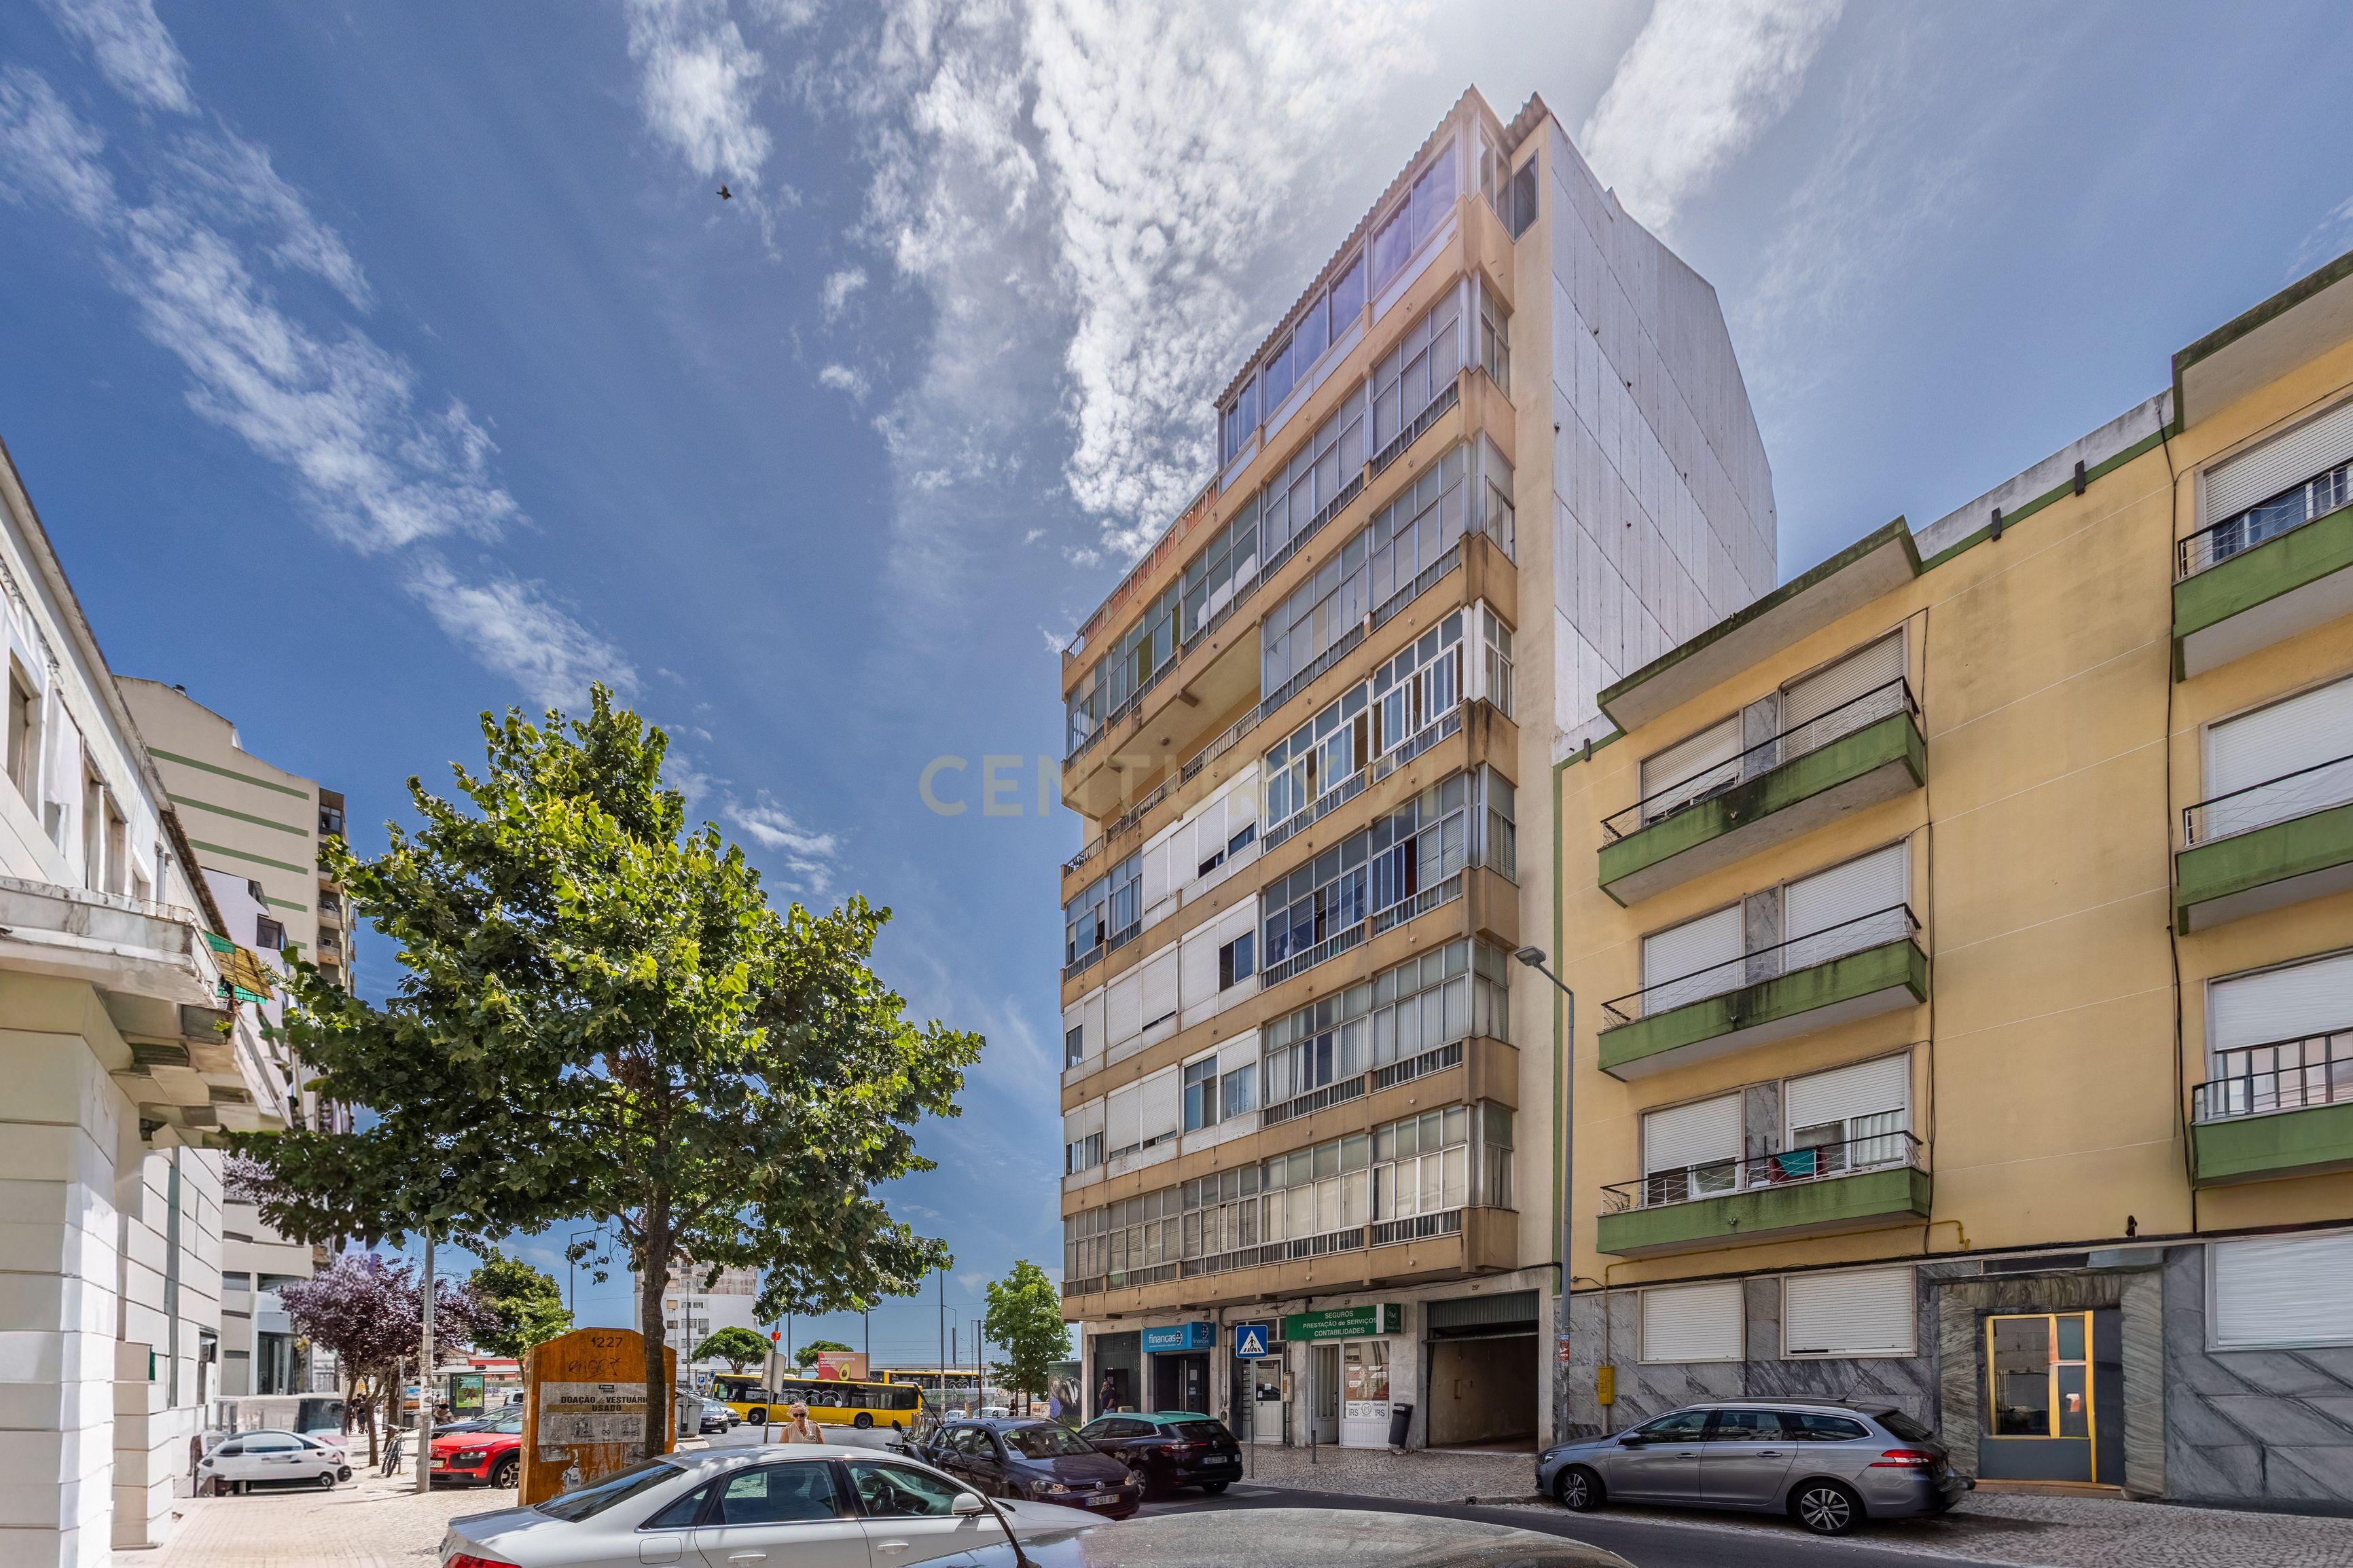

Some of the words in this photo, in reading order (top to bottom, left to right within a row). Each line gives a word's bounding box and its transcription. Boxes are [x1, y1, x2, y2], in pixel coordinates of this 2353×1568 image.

[1325, 1311, 1354, 1319] SEGUROS
[1303, 1320, 1337, 1329] PRESTAÇÃO
[1346, 1317, 1377, 1326] SERVIÇOS
[1314, 1327, 1365, 1336] CONTABILIDADES
[592, 1337, 623, 1348] 1227
[1149, 1333, 1176, 1344] finanças
[560, 1396, 596, 1404] DOAÇÃO
[606, 1396, 647, 1404] VESTUÁRI
